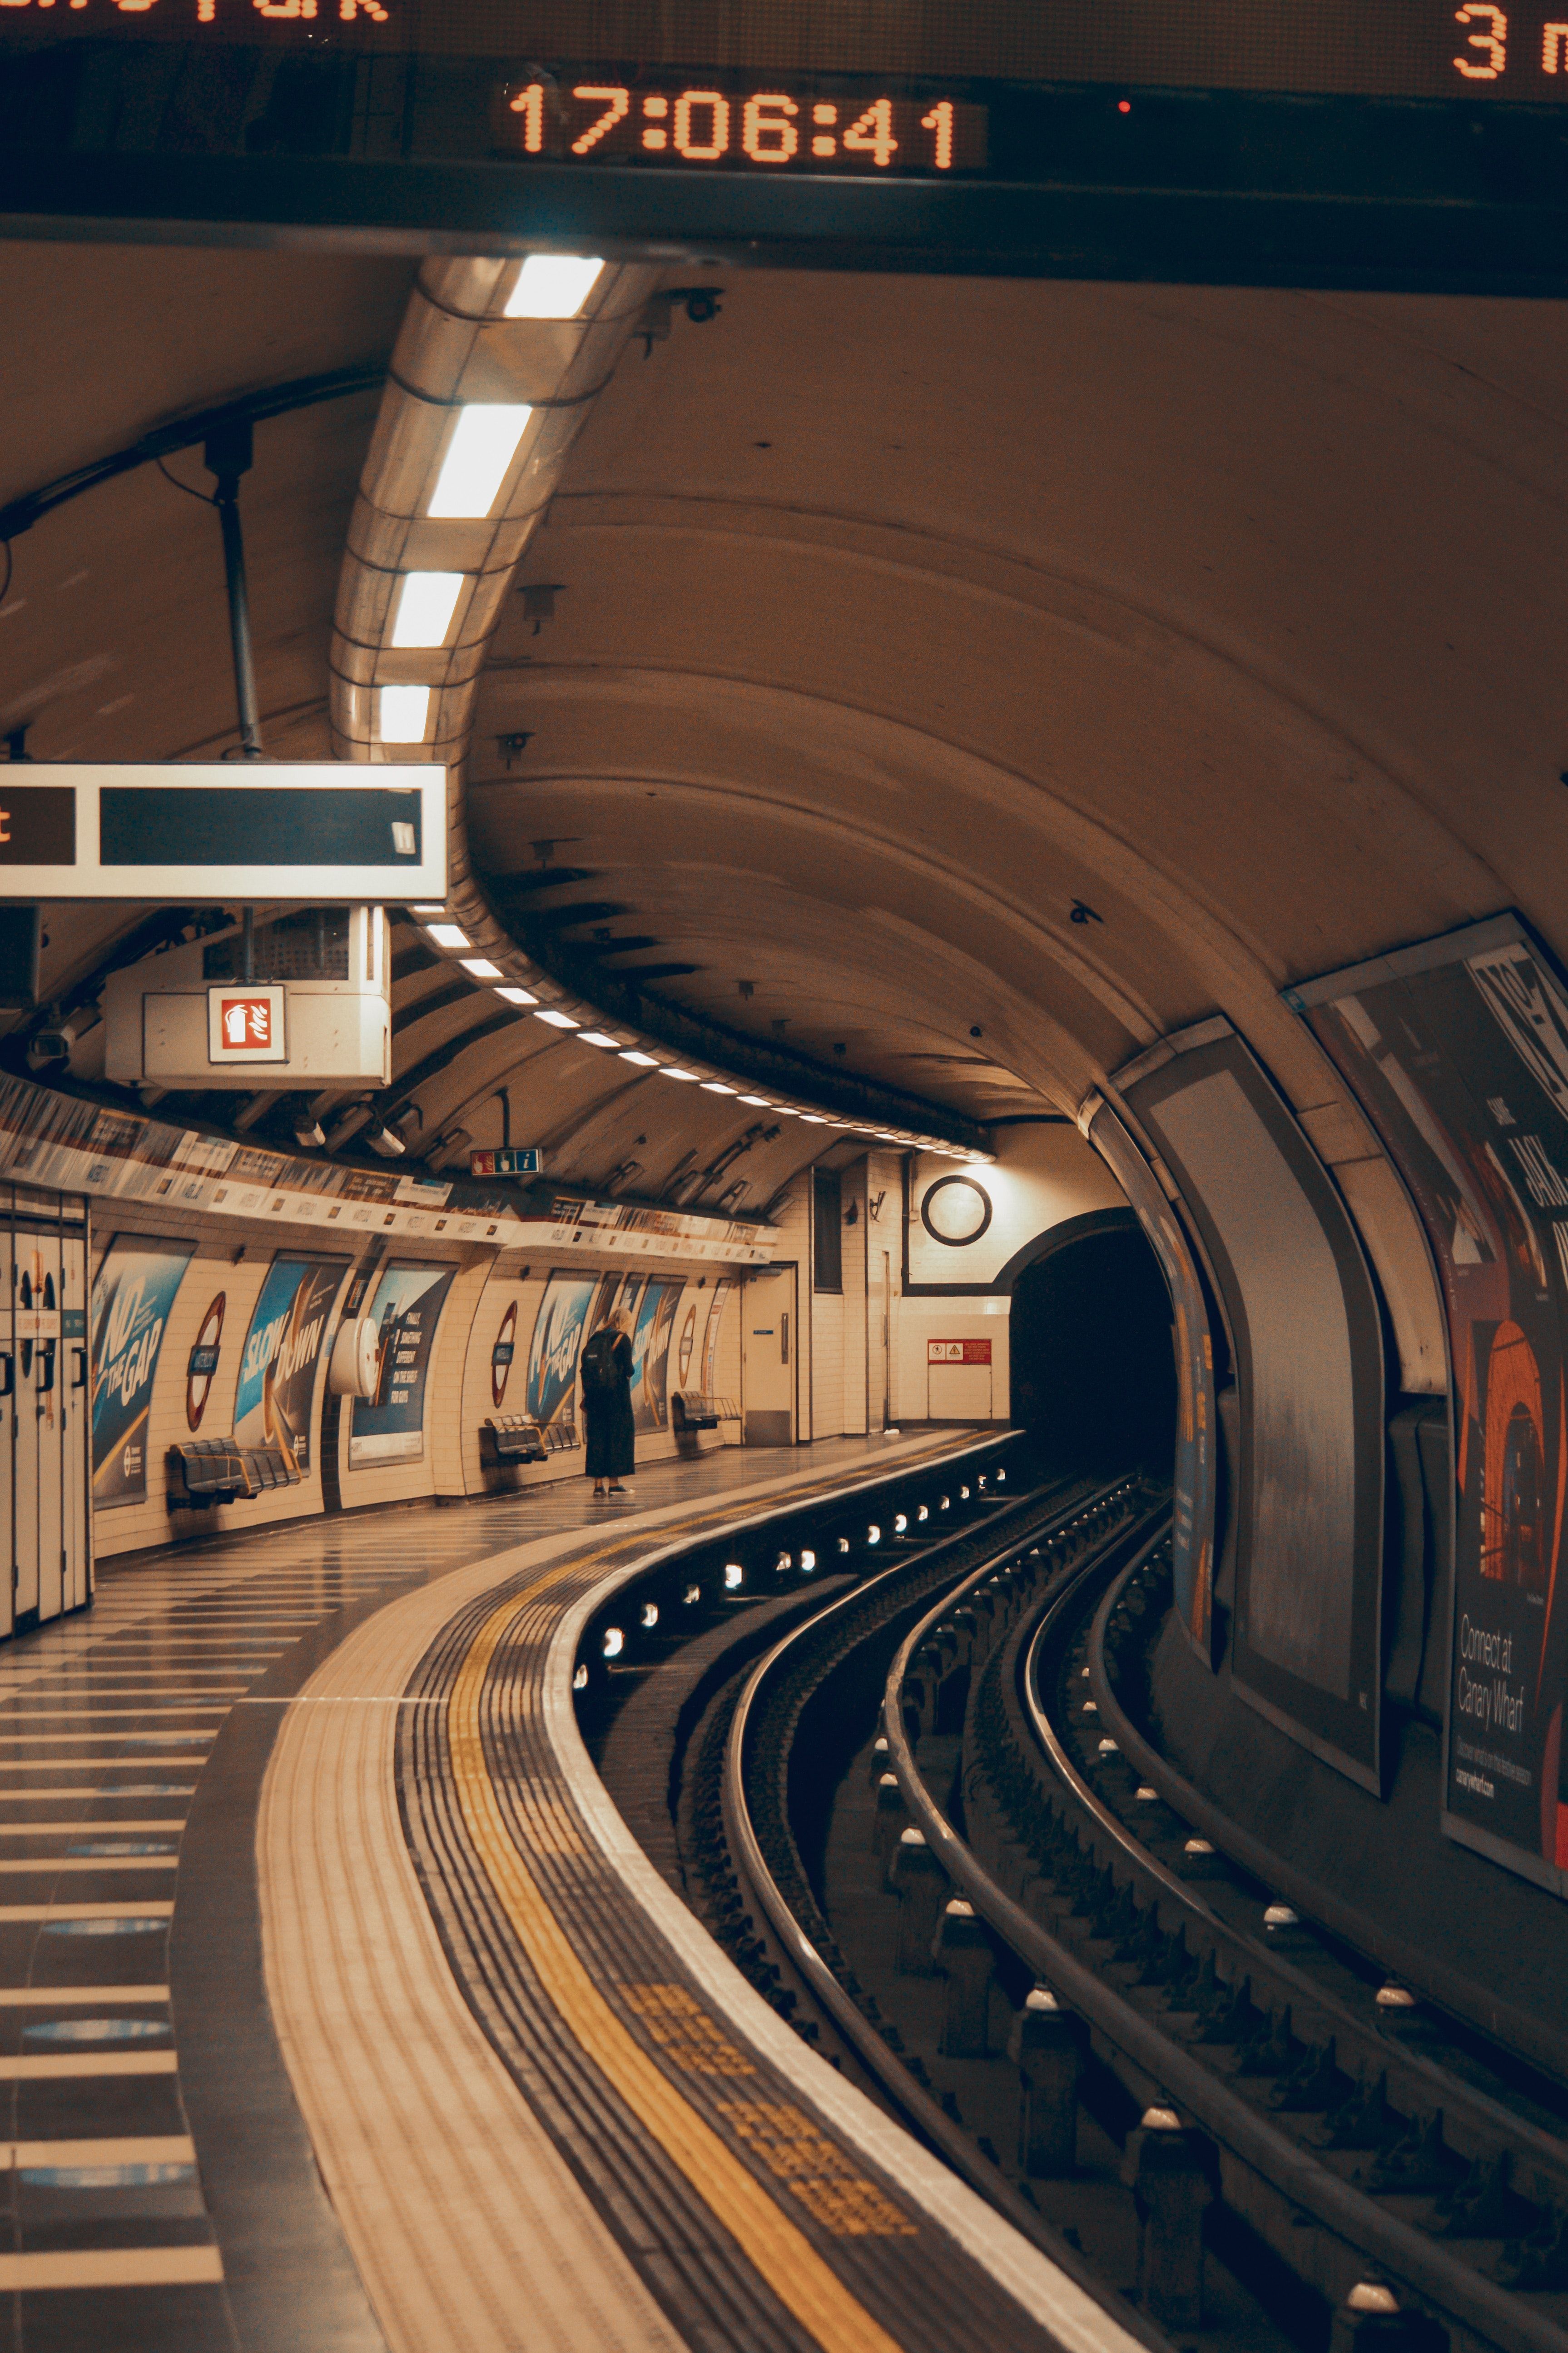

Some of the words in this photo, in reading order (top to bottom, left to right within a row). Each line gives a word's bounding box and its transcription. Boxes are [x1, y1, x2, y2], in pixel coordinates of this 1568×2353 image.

[1453, 3, 1507, 80] 3
[509, 83, 953, 169] 17:06:41
[1507, 1134, 1568, 1209] JACK
[107, 1352, 127, 1399] THE
[121, 1318, 163, 1407] GAP
[242, 1310, 291, 1384] SLOW
[273, 1313, 325, 1391] DOWN
[1460, 1613, 1501, 1670] Connect
[1502, 1631, 1513, 1674] at
[1459, 1666, 1492, 1732] Canary
[1494, 1678, 1524, 1734] Wharf
